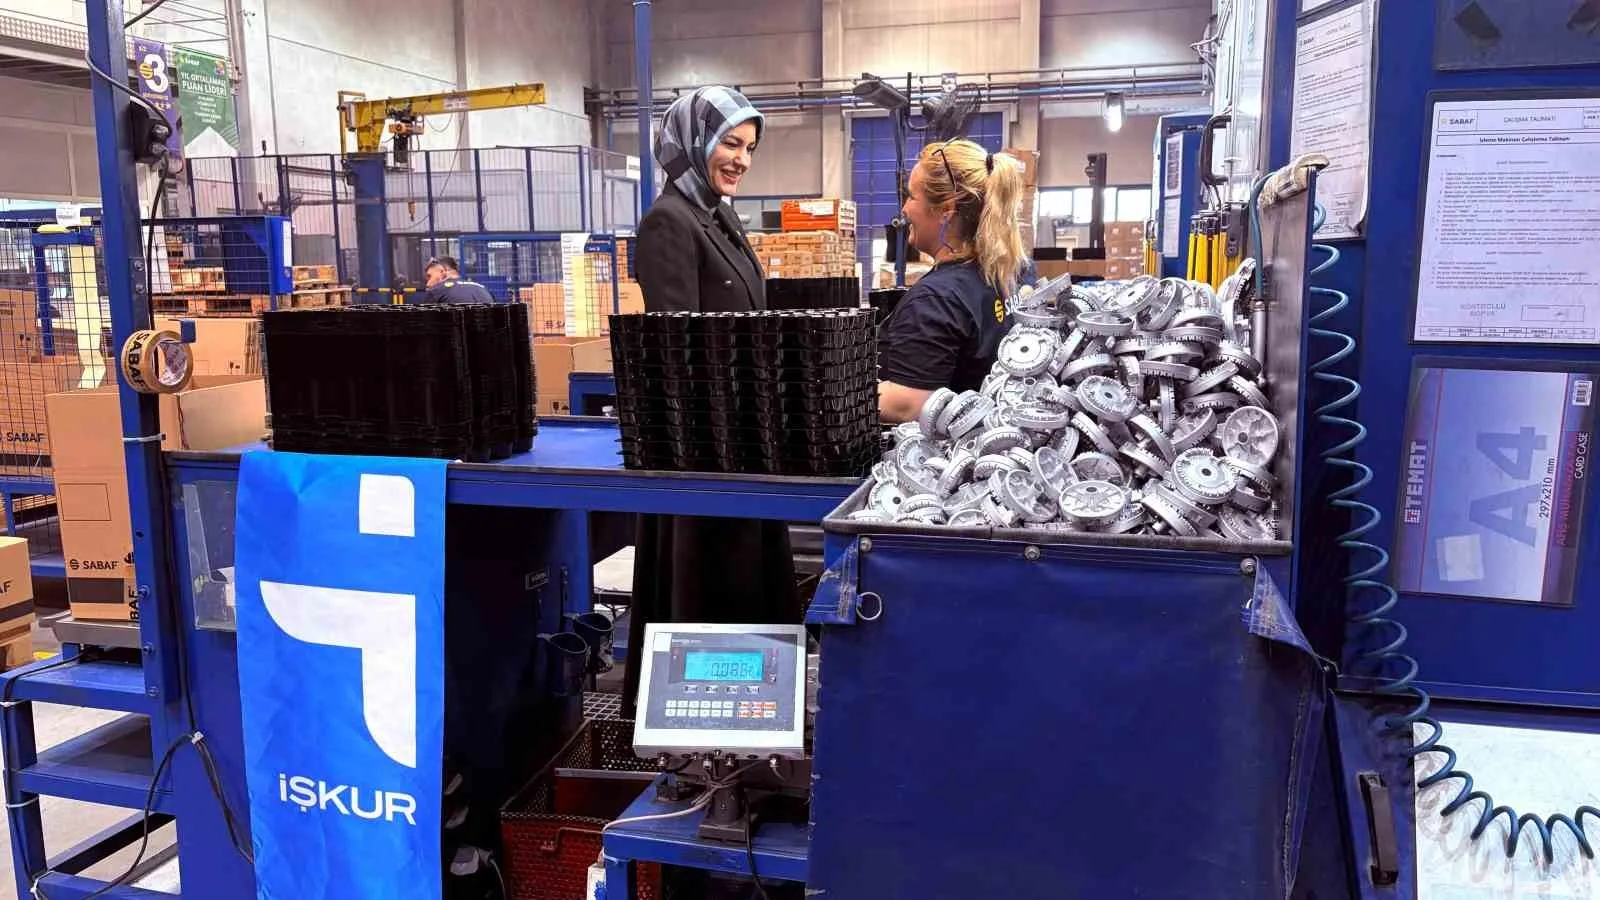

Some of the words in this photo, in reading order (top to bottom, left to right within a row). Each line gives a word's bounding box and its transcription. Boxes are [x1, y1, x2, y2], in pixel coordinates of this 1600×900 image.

[144, 54, 168, 93] 3
[182, 80, 204, 92] PUAN
[6, 432, 46, 442] SABAF
[1576, 431, 1589, 455] CASE
[1574, 456, 1585, 479] CARD
[1469, 426, 1548, 548] A4
[1539, 477, 1553, 519] 297x210
[1547, 457, 1555, 474] mm
[83, 560, 119, 570] SABAF
